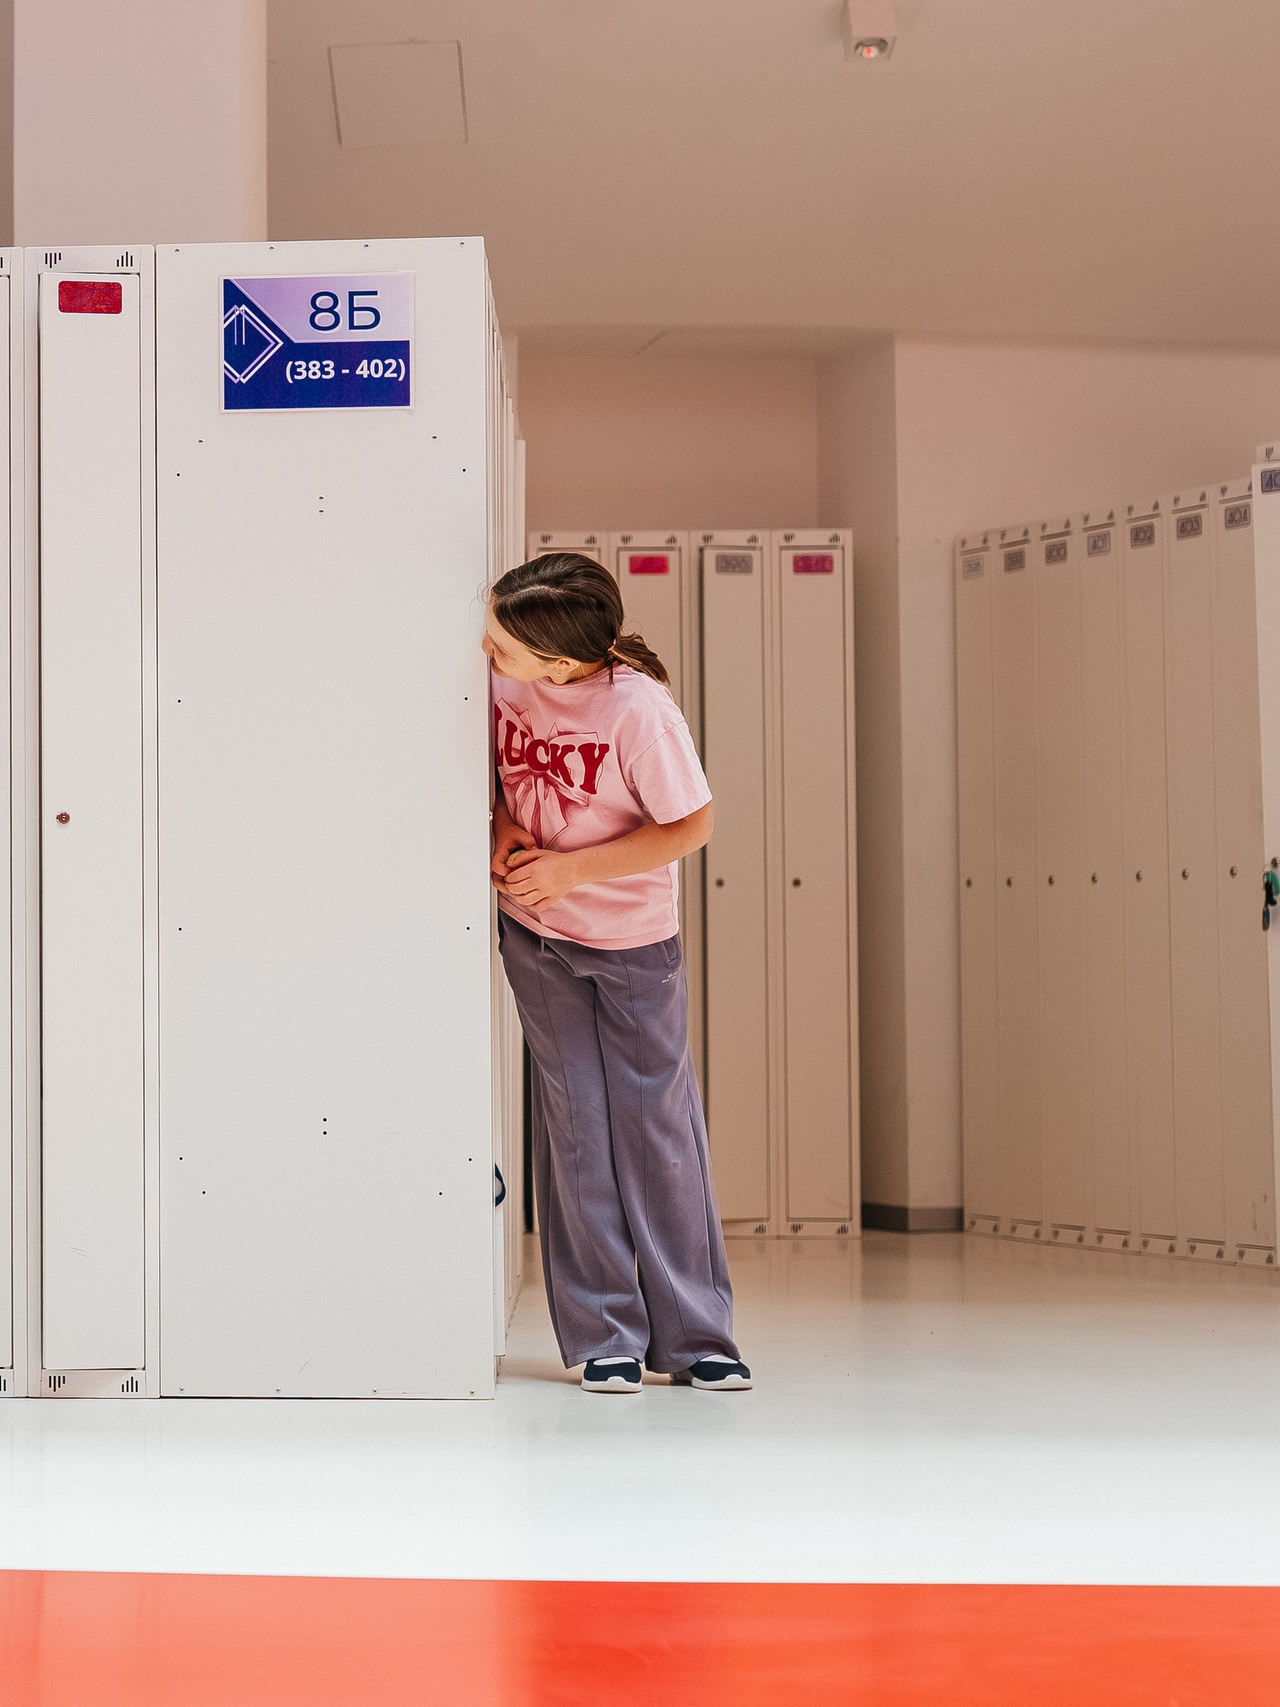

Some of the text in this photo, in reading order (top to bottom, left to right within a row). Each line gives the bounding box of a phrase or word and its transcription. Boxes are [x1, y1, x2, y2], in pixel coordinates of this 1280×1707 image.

[67, 287, 115, 308] 372
[308, 290, 381, 333] 8Б
[285, 360, 335, 384] (383
[355, 358, 406, 382] 402)
[1265, 472, 1280, 489] 40
